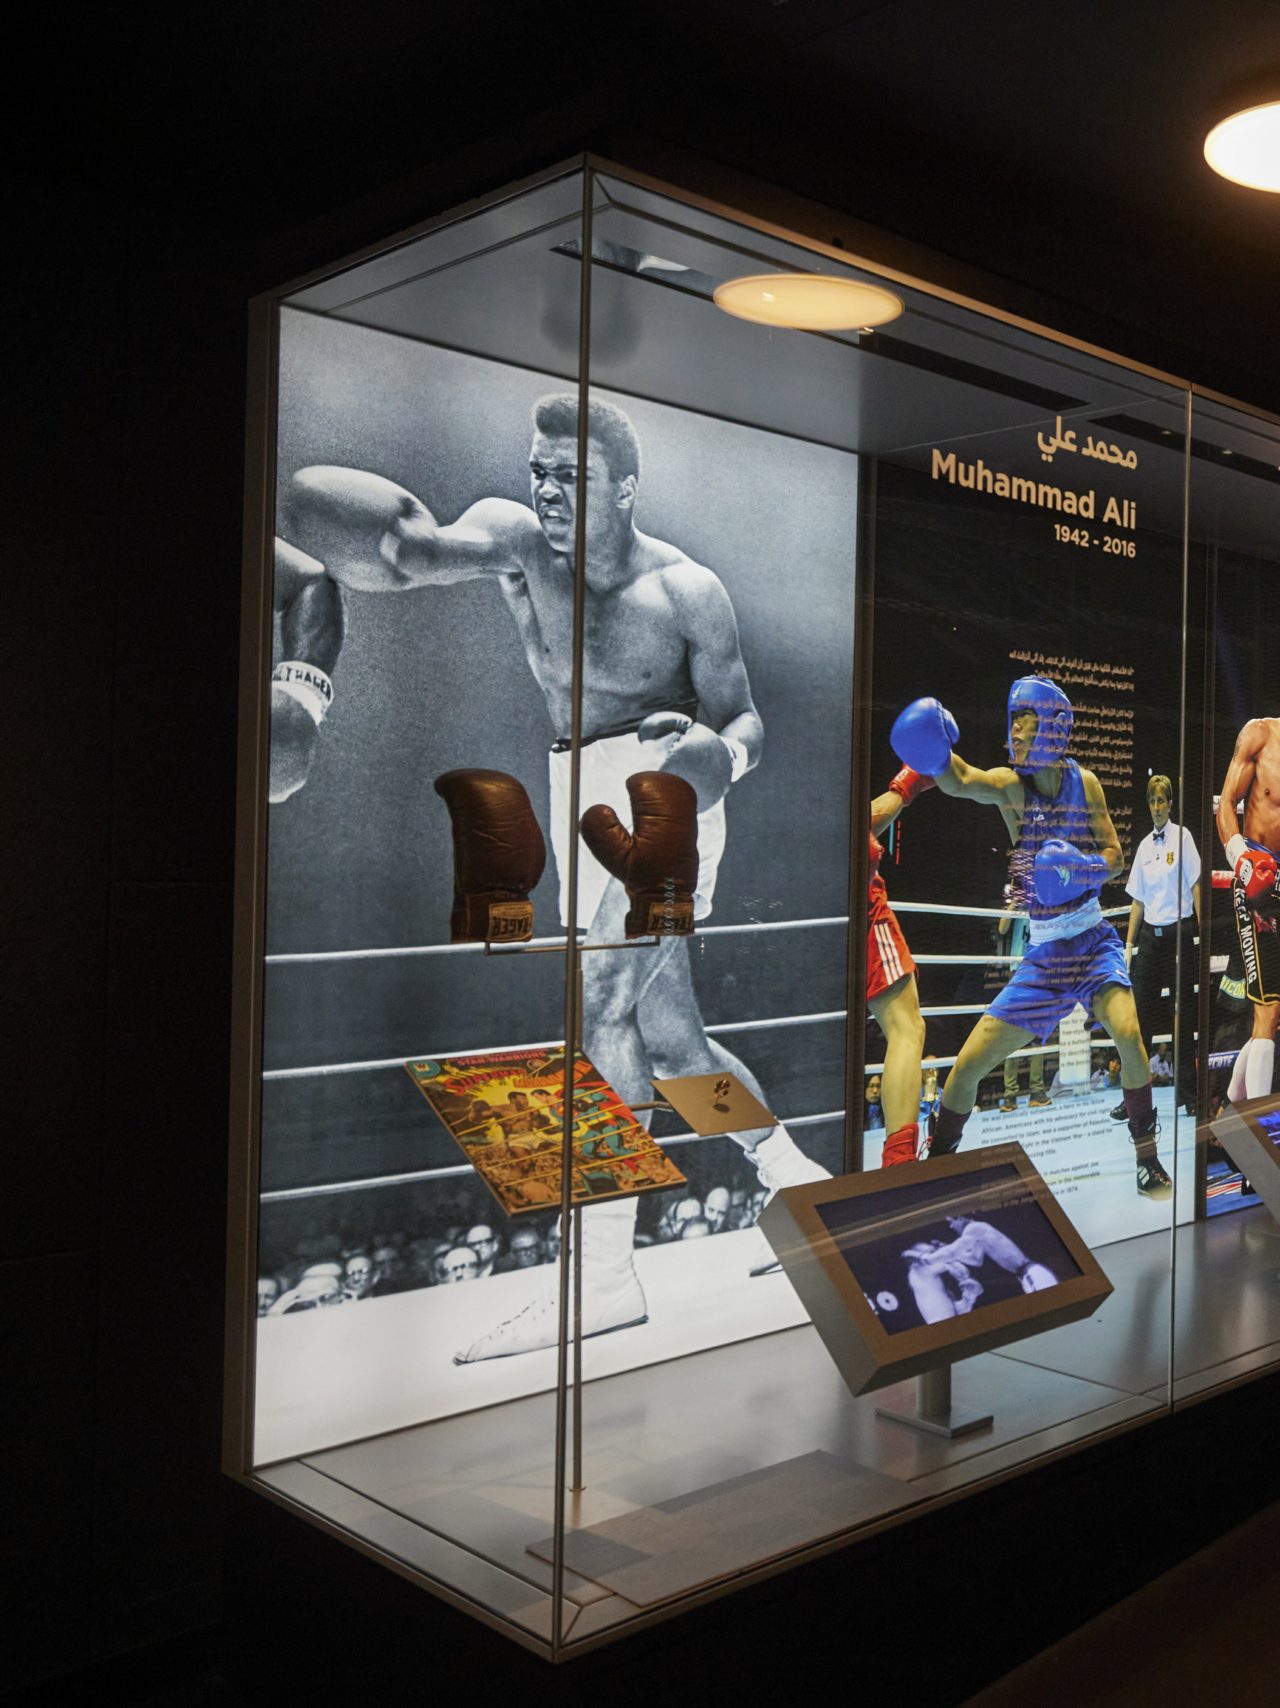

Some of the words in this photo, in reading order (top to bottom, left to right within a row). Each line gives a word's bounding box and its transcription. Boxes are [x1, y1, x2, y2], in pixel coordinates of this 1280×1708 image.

[1037, 415, 1077, 463] علي
[1082, 435, 1137, 470] محمد
[931, 449, 1095, 520] Muhammad
[1103, 496, 1136, 529] Ali
[1054, 524, 1090, 547] 1942
[1103, 536, 1136, 558] 2016
[1235, 888, 1250, 922] KEEP
[1240, 924, 1257, 984] MOVING
